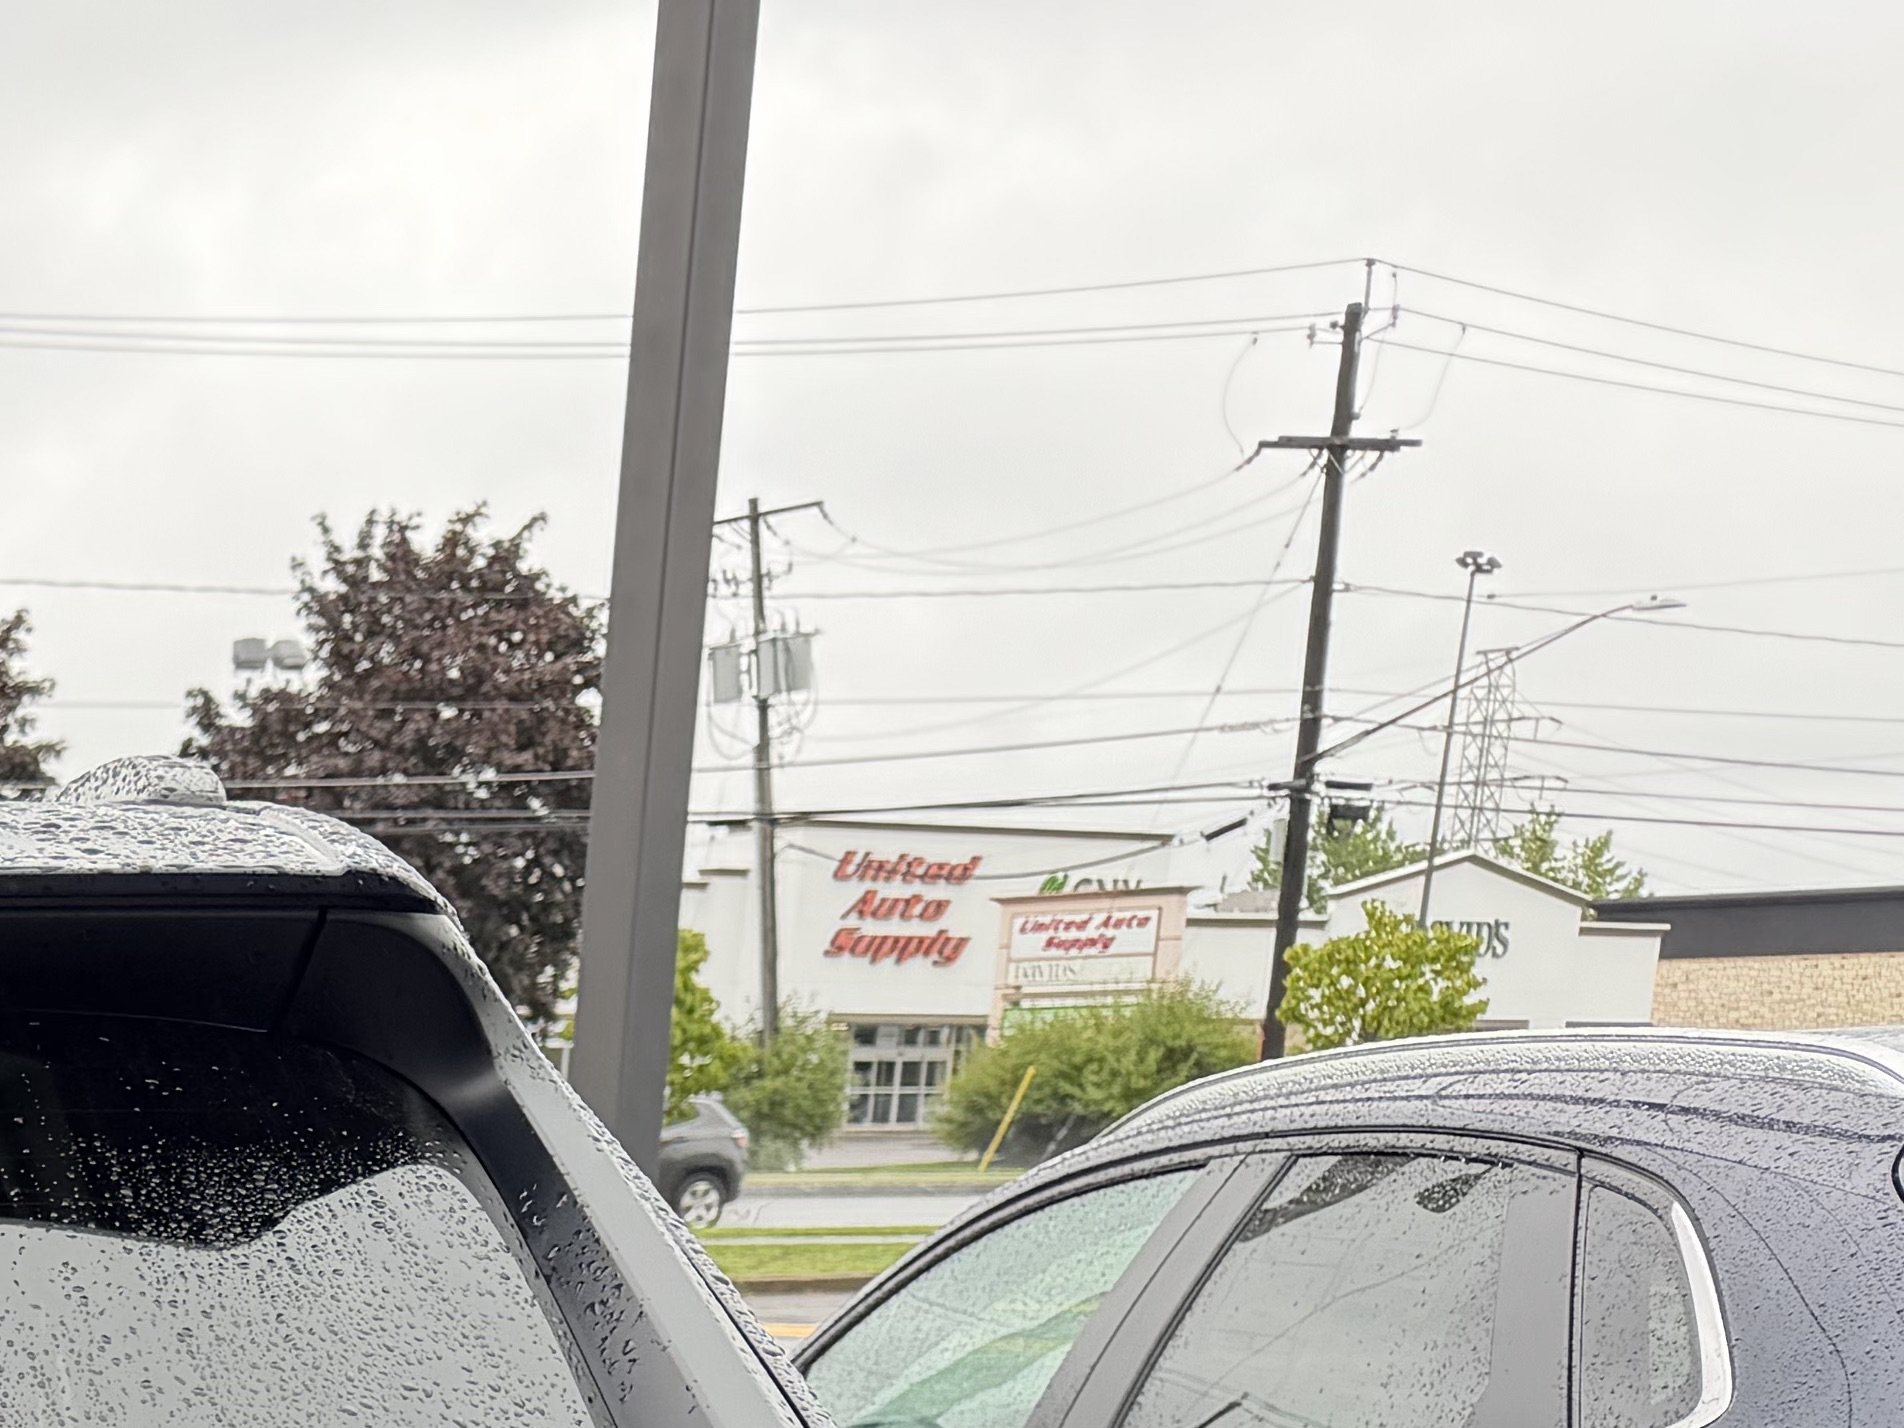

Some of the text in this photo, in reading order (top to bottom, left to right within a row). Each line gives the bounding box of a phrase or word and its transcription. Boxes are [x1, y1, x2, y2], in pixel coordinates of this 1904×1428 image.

[833, 850, 983, 885] United
[840, 889, 952, 922] Auto
[1019, 916, 1092, 935] United
[823, 927, 972, 966] Supply
